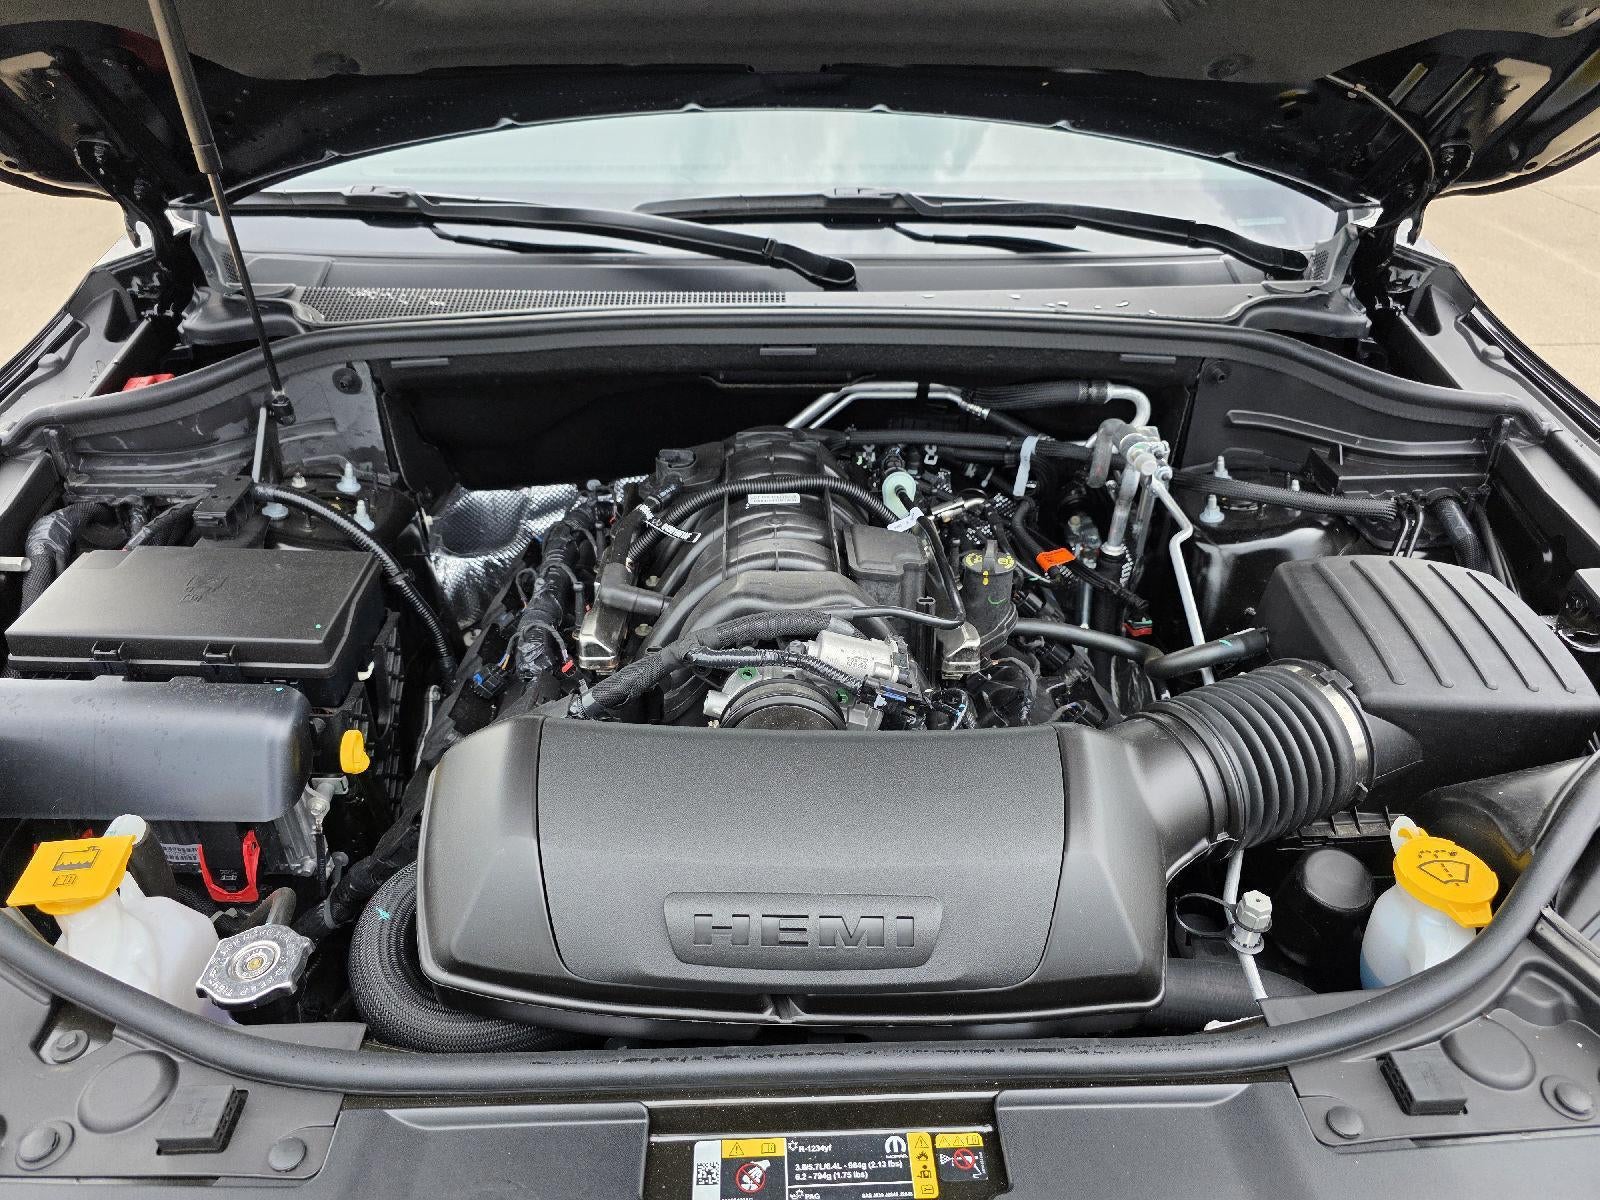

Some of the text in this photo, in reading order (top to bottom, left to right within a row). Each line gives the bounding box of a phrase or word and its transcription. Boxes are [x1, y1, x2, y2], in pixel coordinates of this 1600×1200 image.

[693, 913, 914, 949] HEMI
[798, 1144, 832, 1153] R-1234yf
[868, 1160, 887, 1170] (2.13
[887, 1159, 903, 1169] lbs)
[813, 1172, 832, 1181] 794g
[833, 1171, 852, 1180] (1.75
[853, 1170, 868, 1179] lbs)
[804, 1192, 820, 1200] PAG
